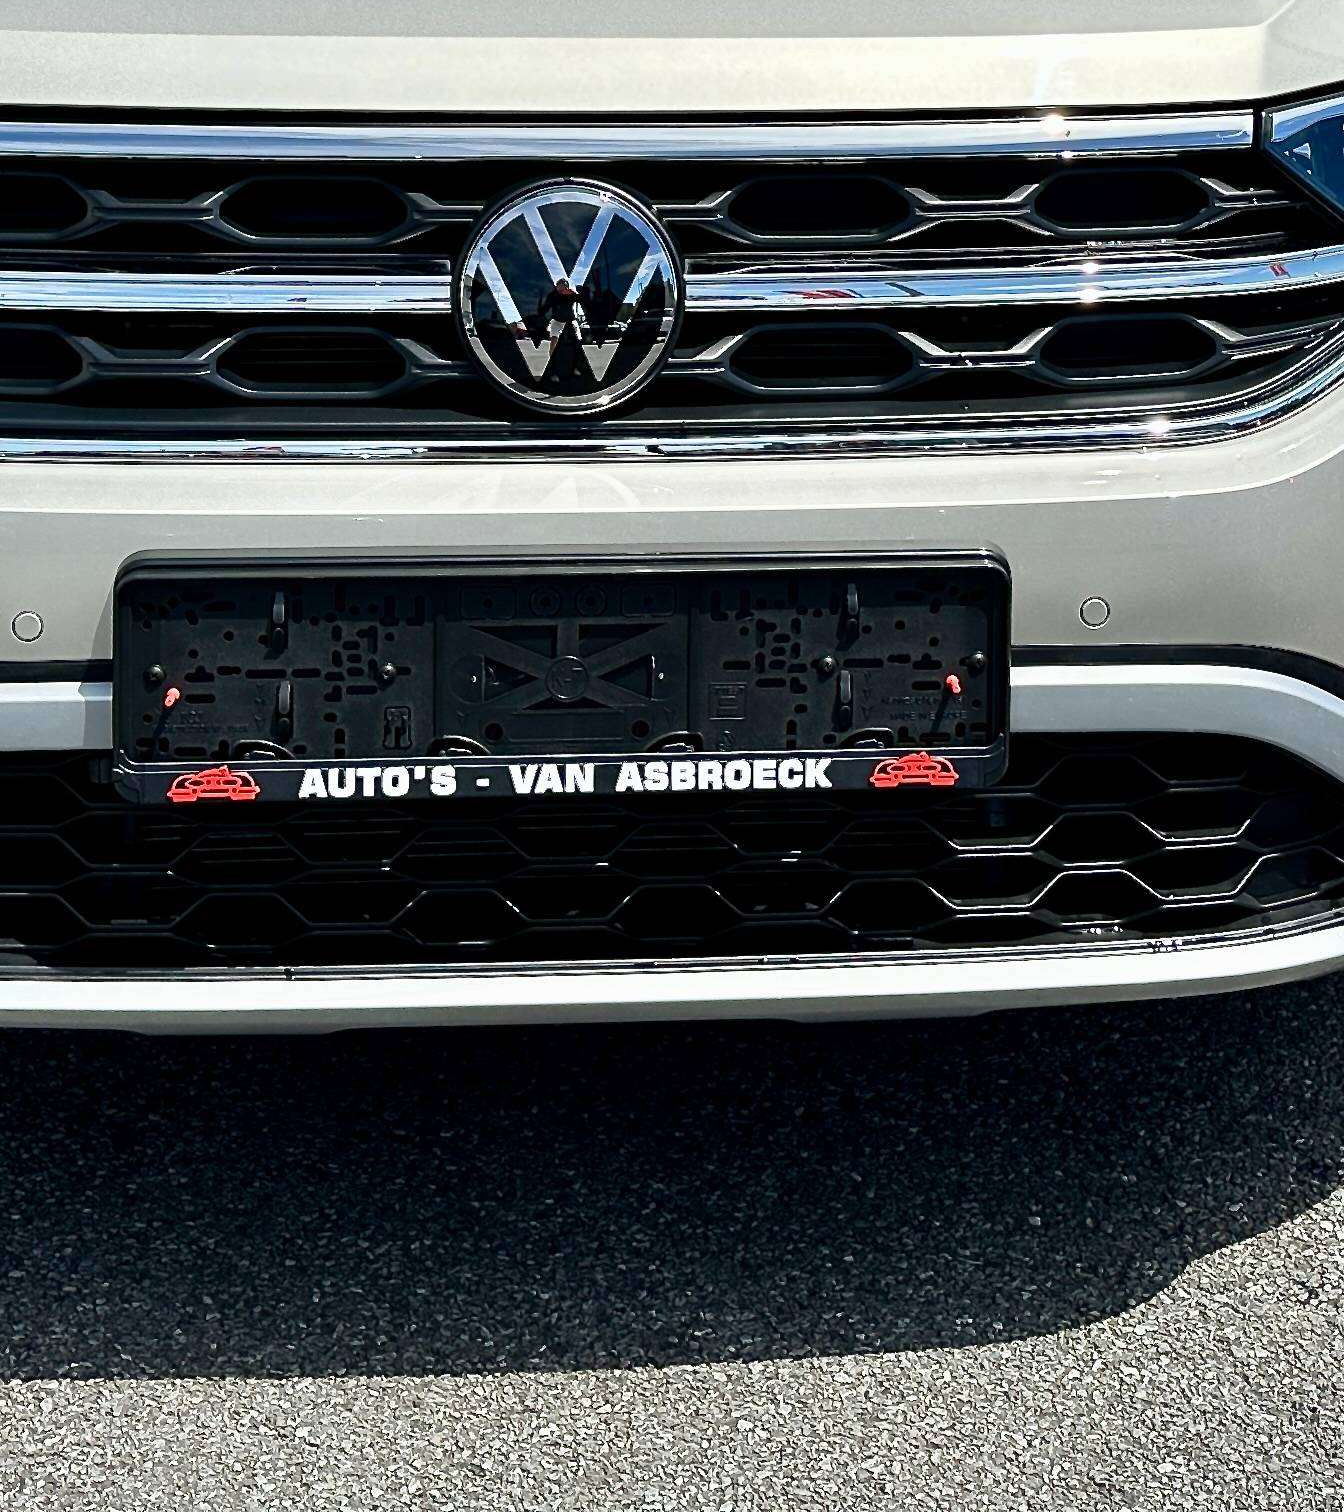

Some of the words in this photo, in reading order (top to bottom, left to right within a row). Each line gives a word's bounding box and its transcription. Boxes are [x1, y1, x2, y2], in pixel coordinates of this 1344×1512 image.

[298, 765, 456, 799] AUTO'S
[509, 763, 595, 794] VAN
[615, 758, 833, 791] ASBROECK
